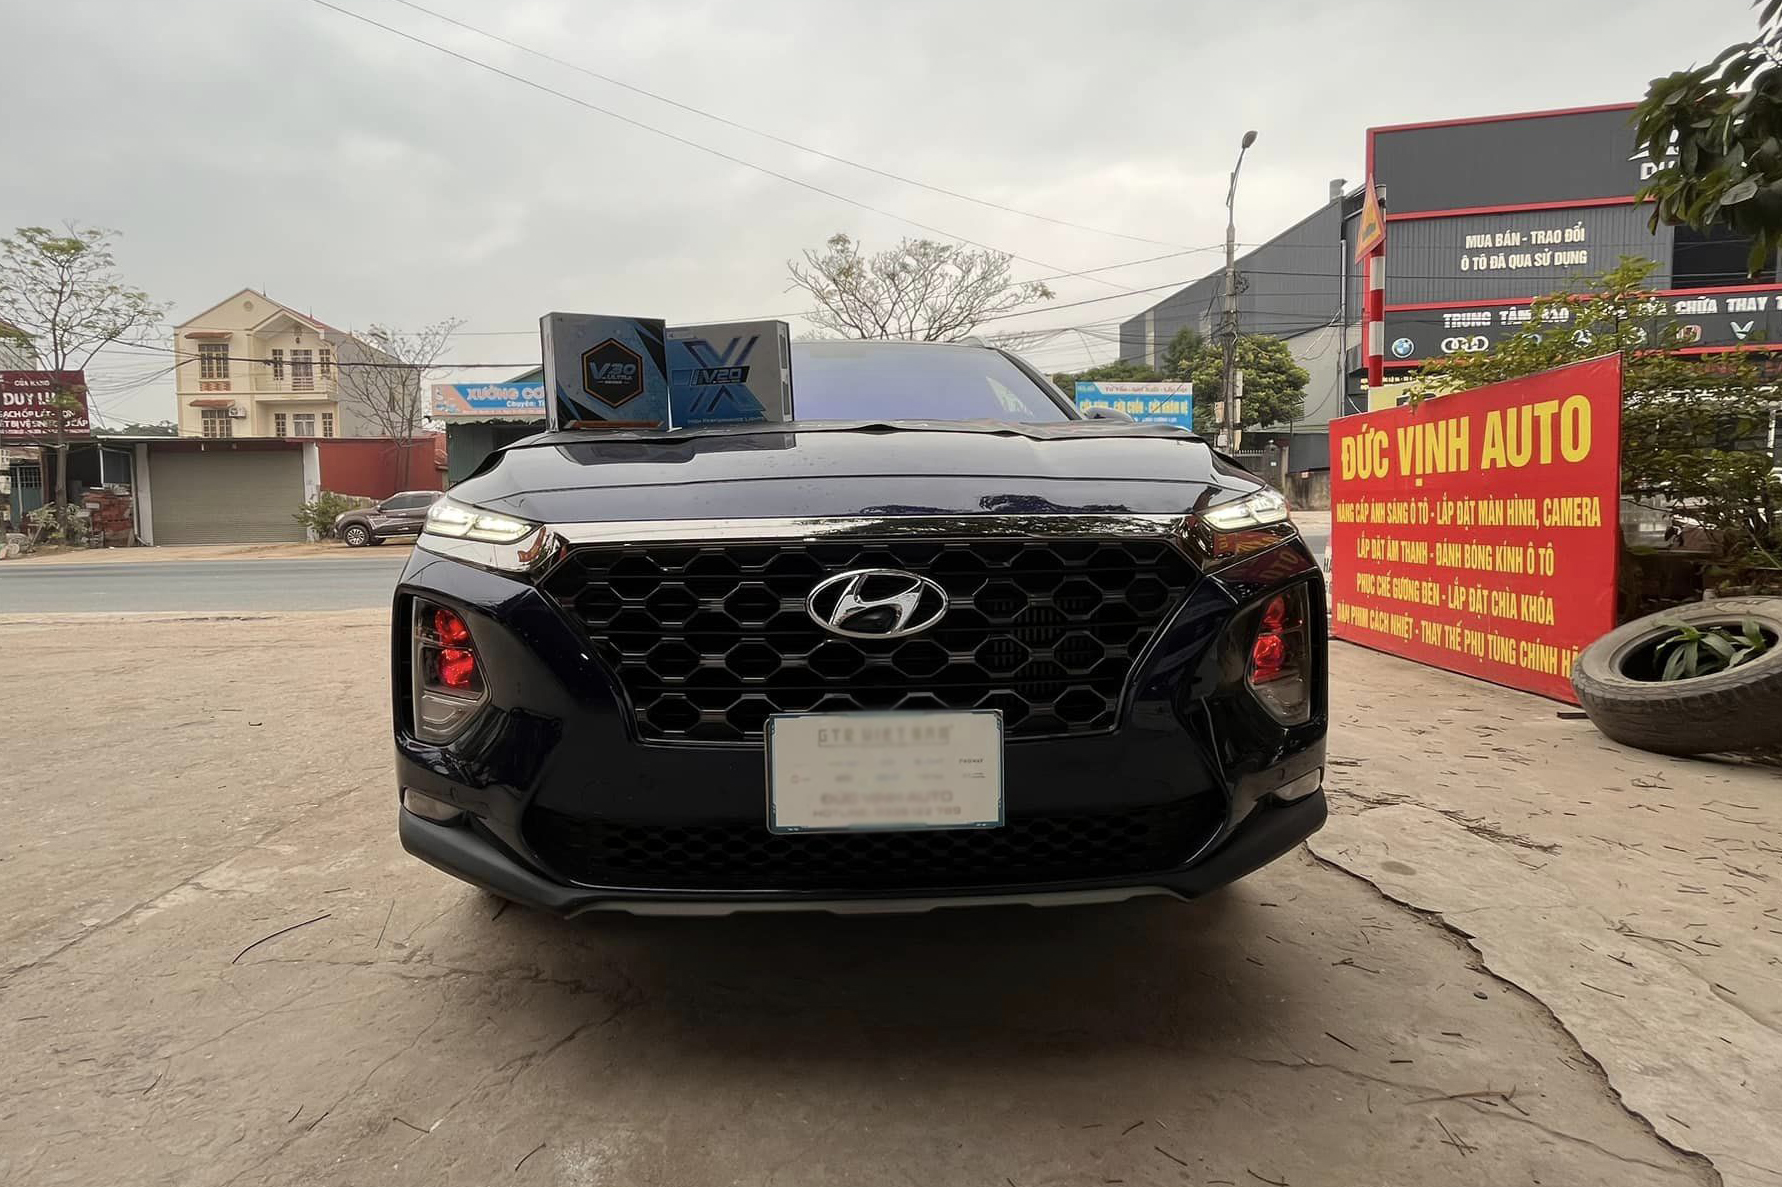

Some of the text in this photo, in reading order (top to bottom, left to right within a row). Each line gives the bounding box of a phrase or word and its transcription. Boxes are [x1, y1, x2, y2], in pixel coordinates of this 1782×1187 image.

[1466, 234, 1492, 249] MUA
[1495, 230, 1520, 247] BÁN
[1530, 229, 1562, 245] TRAO
[1564, 221, 1585, 243] ĐỔI
[1461, 248, 1587, 271] Ô TÔ ĐÃ QUA SỬ DỤNG
[1443, 311, 1491, 328] TRUNG
[1675, 296, 1718, 314] CHỮA
[1726, 297, 1768, 312] THAY
[2, 392, 34, 405] DUY
[1341, 394, 1591, 487] ĐỨC VỊNH AUTO
[1356, 495, 1369, 522] CẤP
[1387, 498, 1408, 524] SÁNG
[1410, 497, 1416, 524] Ô
[1418, 496, 1429, 524] TÔ
[1437, 492, 1454, 525] LẮP
[1456, 495, 1476, 530] ĐẶT
[1478, 494, 1503, 526] MÀN
[1507, 493, 1539, 530] HÌNH,
[1543, 497, 1601, 527] CAMERA
[1357, 530, 1370, 558] LẮP
[1371, 535, 1385, 564] ĐẶT
[1387, 535, 1399, 562] ÂM
[1401, 540, 1428, 565] THANH
[1436, 538, 1461, 568] ĐÁNH
[1464, 539, 1492, 571] BÓNG
[1496, 540, 1523, 574] KÍNH
[1527, 541, 1535, 574] Ô
[1538, 542, 1554, 576] TÔ
[1357, 572, 1375, 598] PHỤC
[1376, 570, 1391, 597] CHẾ
[1422, 577, 1440, 606] ĐÈN
[1448, 577, 1466, 610] LẮP
[1469, 584, 1489, 619] ĐẶT
[1491, 586, 1518, 620] CHÌA
[1521, 590, 1554, 626] KHÓA
[1351, 605, 1369, 628] PHIM
[1370, 606, 1389, 634] CÁCH
[1391, 612, 1414, 642] NHIỆT
[1421, 620, 1443, 647] THAY
[1444, 620, 1463, 651] THẾ
[1464, 629, 1485, 663] PHỤ
[1487, 630, 1516, 665] TÙNG
[1520, 638, 1558, 675] CHÍNH
